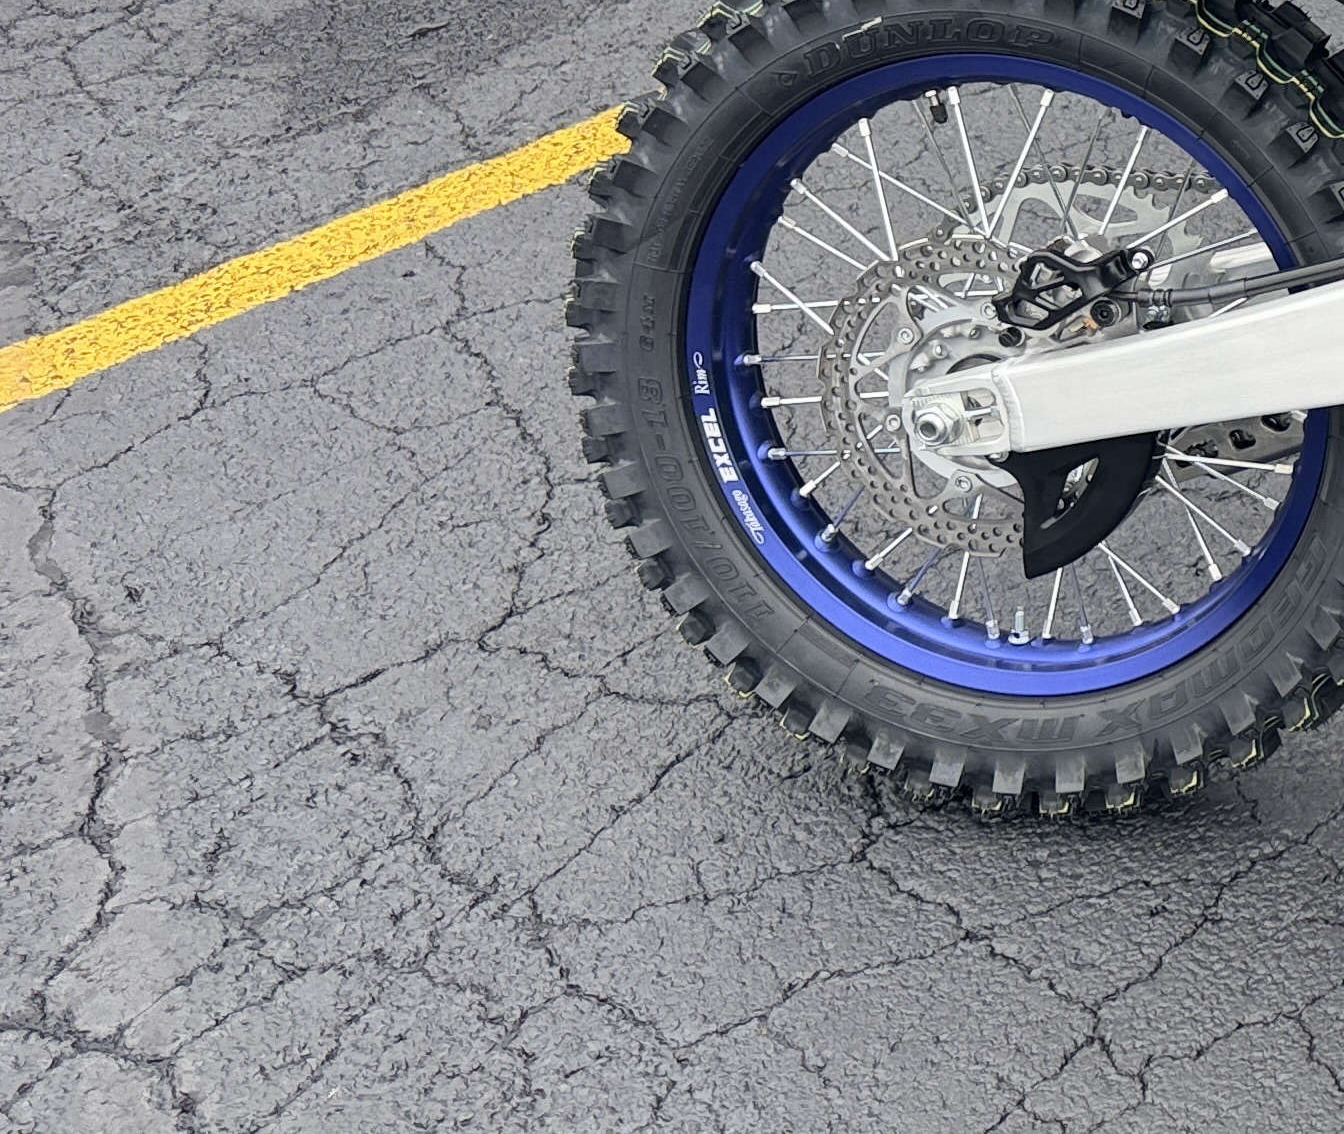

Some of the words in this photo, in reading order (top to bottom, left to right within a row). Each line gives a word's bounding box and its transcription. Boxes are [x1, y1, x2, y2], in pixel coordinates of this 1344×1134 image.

[803, 17, 1055, 79] DUNLOP
[693, 352, 711, 396] Rim
[701, 407, 739, 484] EXCEL
[637, 375, 775, 626] 110/100-18
[866, 683, 1086, 744] MX33
